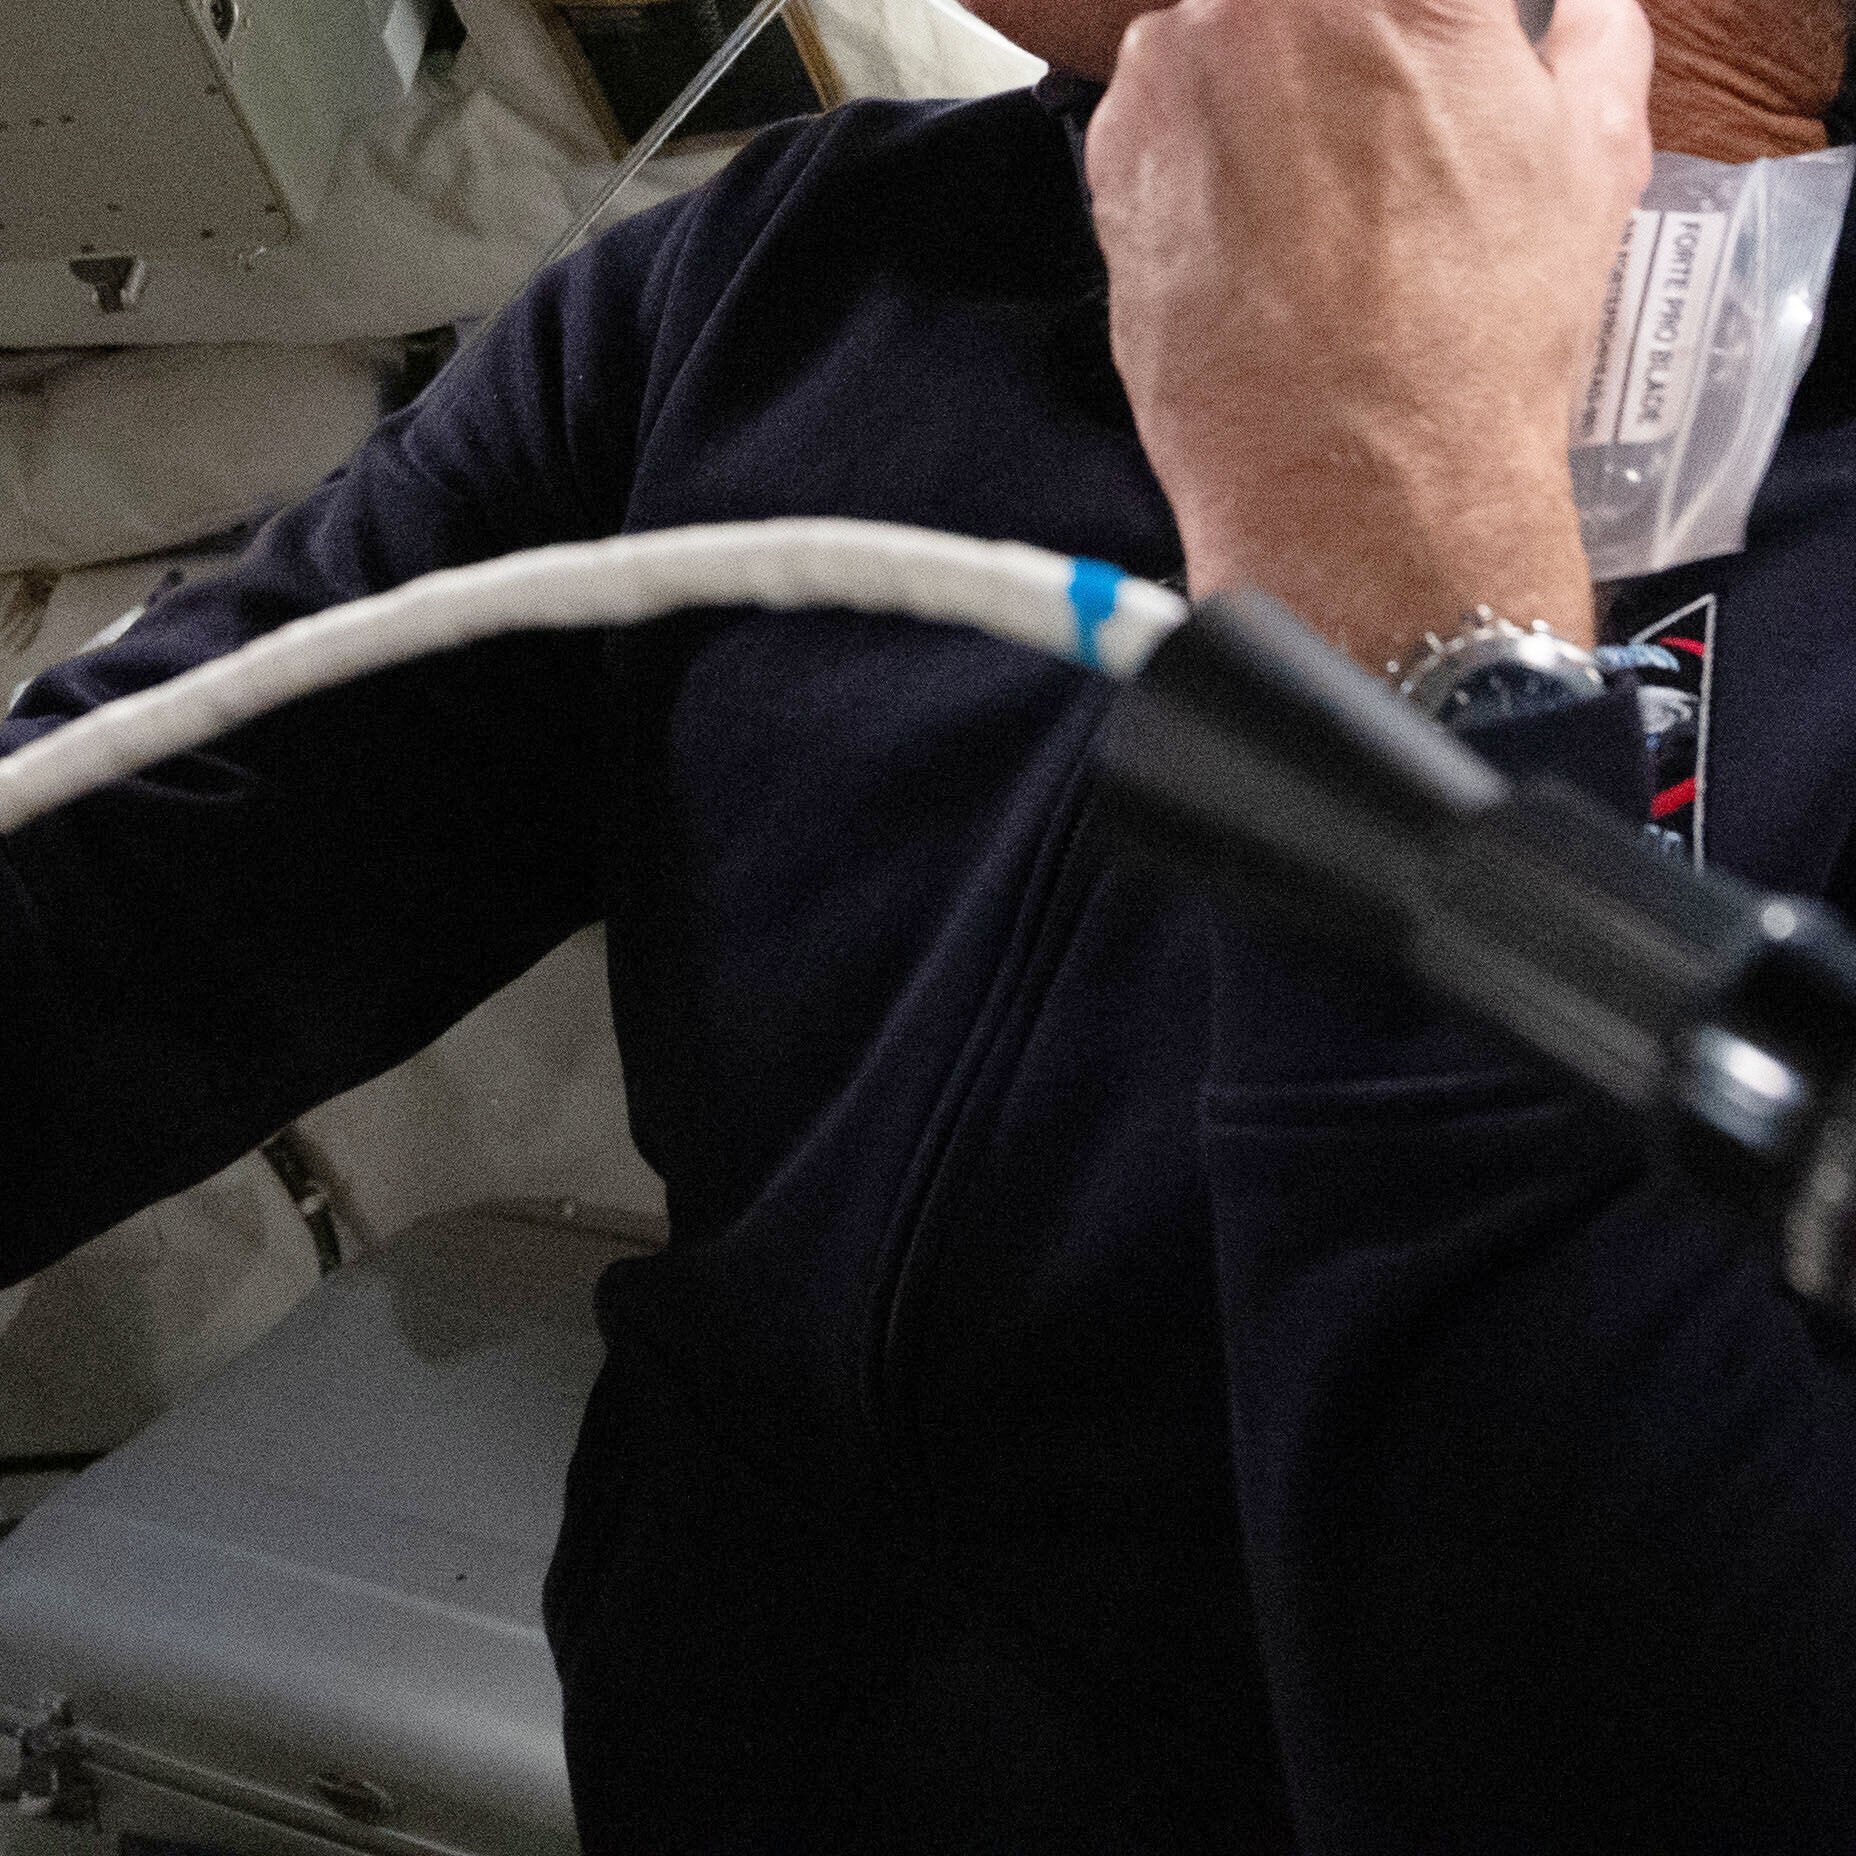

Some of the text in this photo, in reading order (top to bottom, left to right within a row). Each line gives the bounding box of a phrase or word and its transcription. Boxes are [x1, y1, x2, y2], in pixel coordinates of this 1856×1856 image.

[1636, 220, 1702, 424] FORTE PRO BLADE
